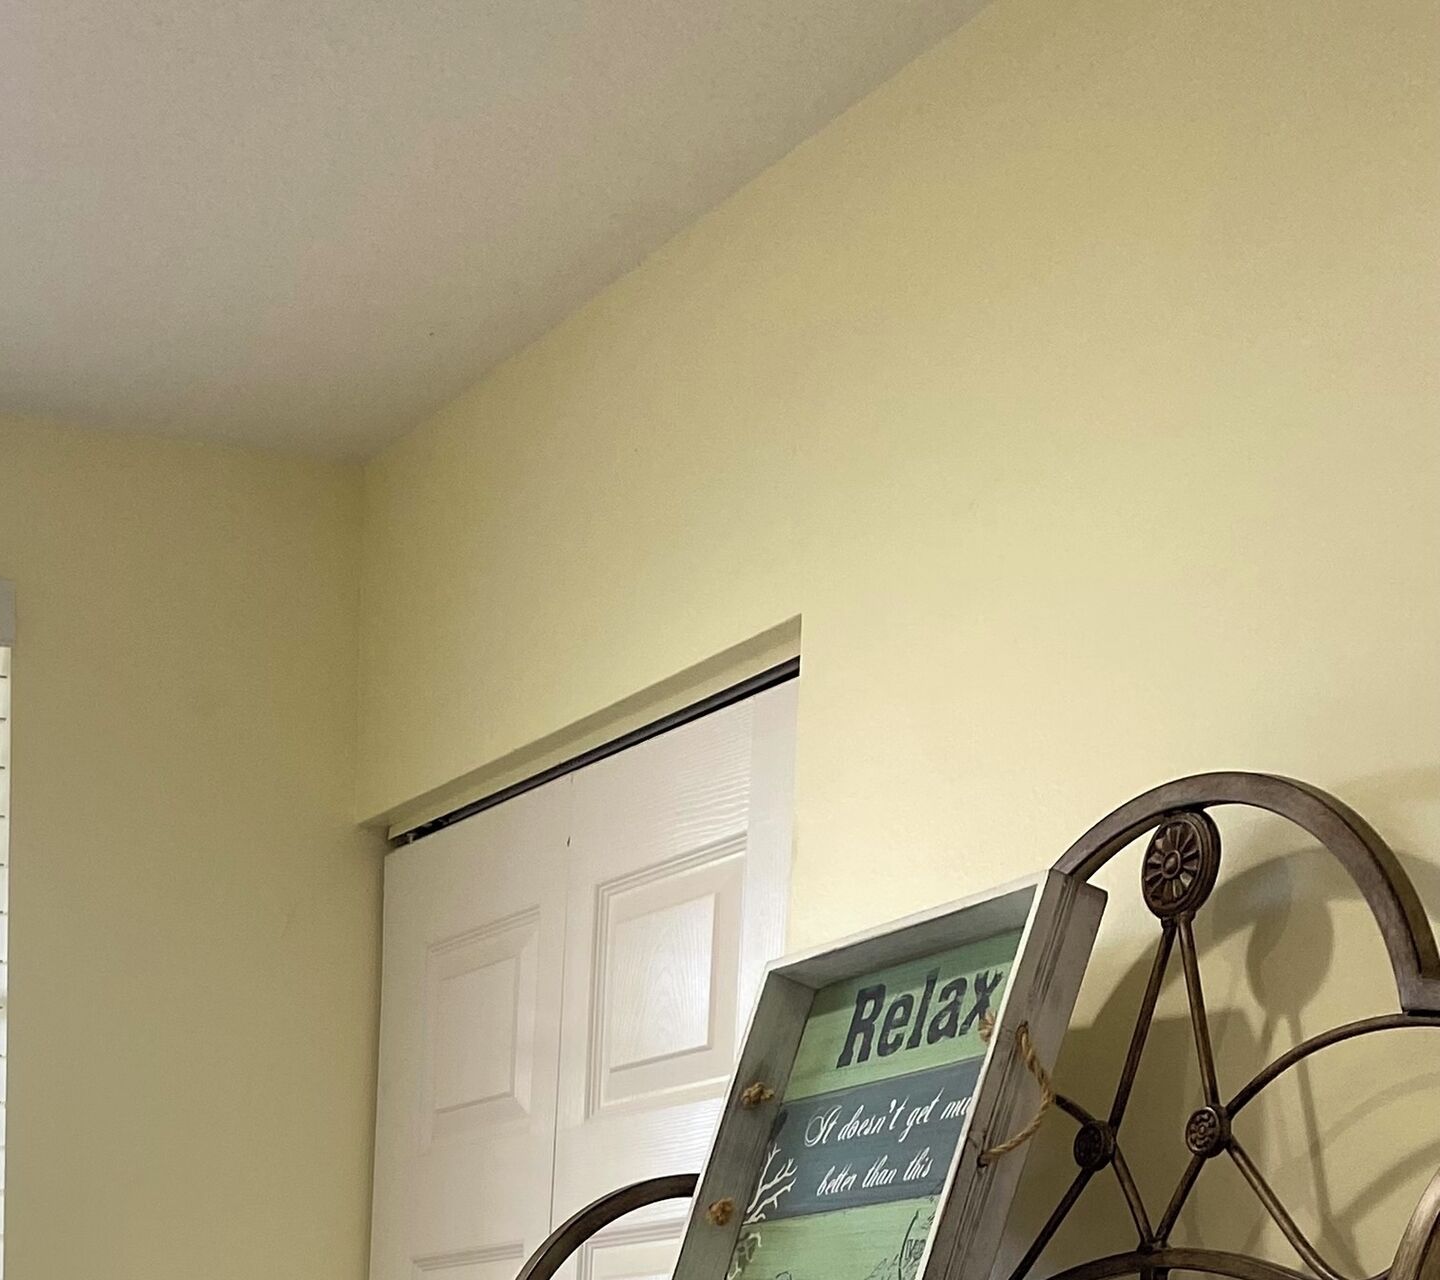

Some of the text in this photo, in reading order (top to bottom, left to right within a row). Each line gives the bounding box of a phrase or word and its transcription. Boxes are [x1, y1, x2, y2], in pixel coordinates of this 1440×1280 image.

[836, 967, 1003, 1068] Relax
[804, 1104, 842, 1148] It
[837, 1098, 910, 1142] doesn't
[898, 1087, 944, 1143] get
[816, 1146, 934, 1197] better than this
